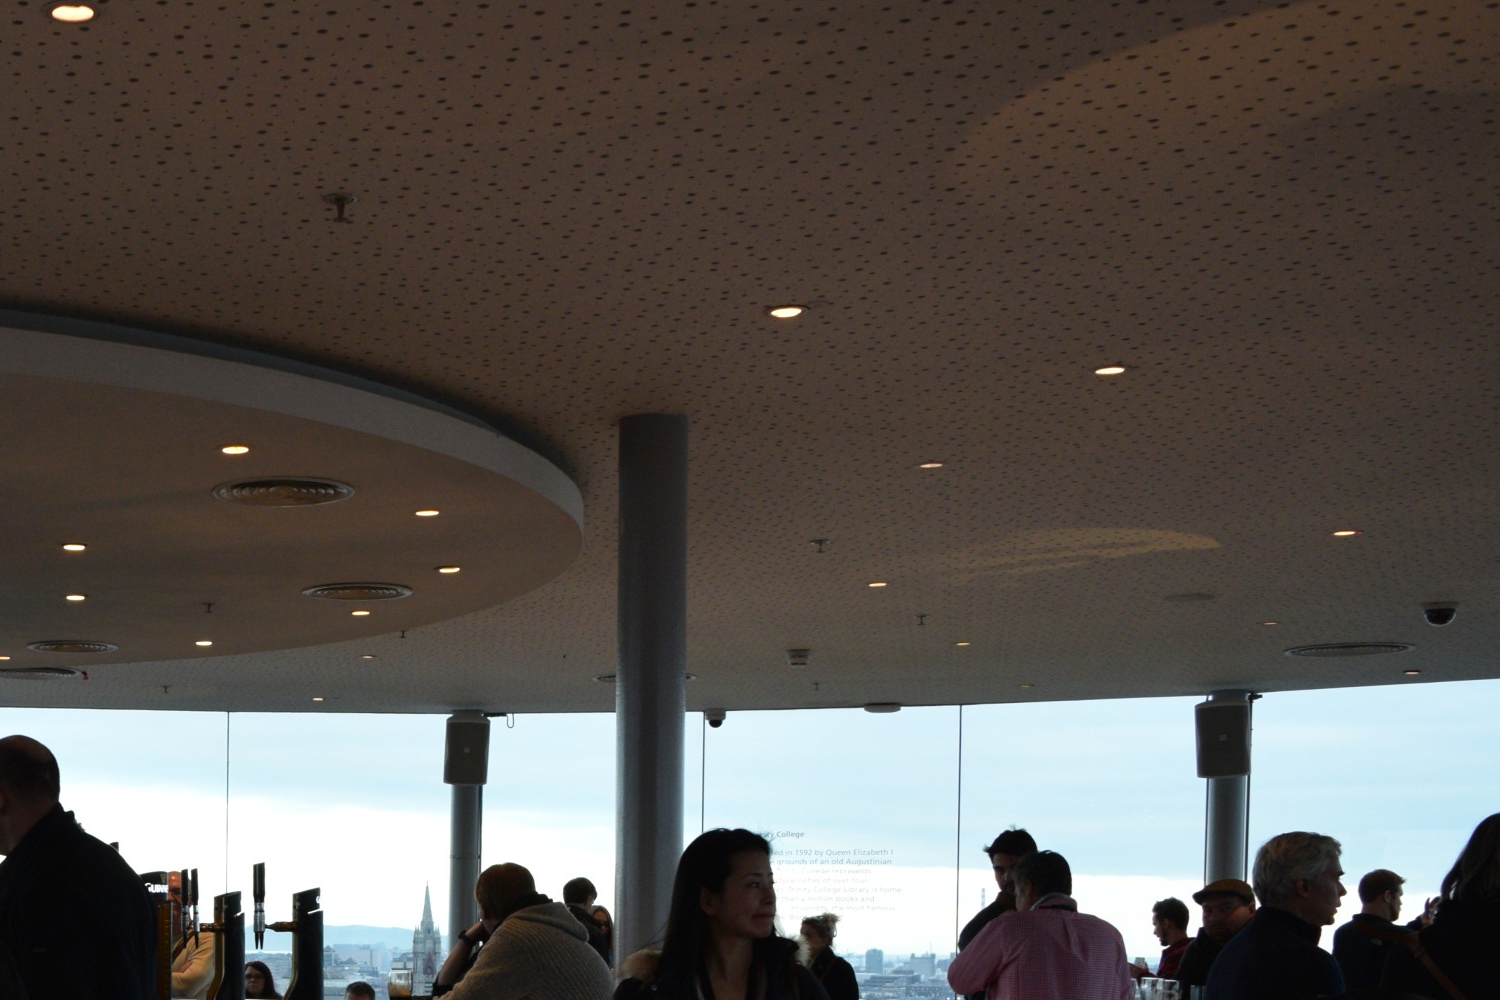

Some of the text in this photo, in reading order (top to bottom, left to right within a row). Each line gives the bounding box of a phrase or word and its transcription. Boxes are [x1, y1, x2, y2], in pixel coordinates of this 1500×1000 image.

[776, 830, 805, 840] College
[795, 848, 813, 856] 1592
[814, 848, 824, 857] by
[826, 848, 851, 857] Queen
[853, 848, 889, 856] Elizabeth
[776, 858, 808, 867] grounds
[846, 858, 892, 867] Augustinian
